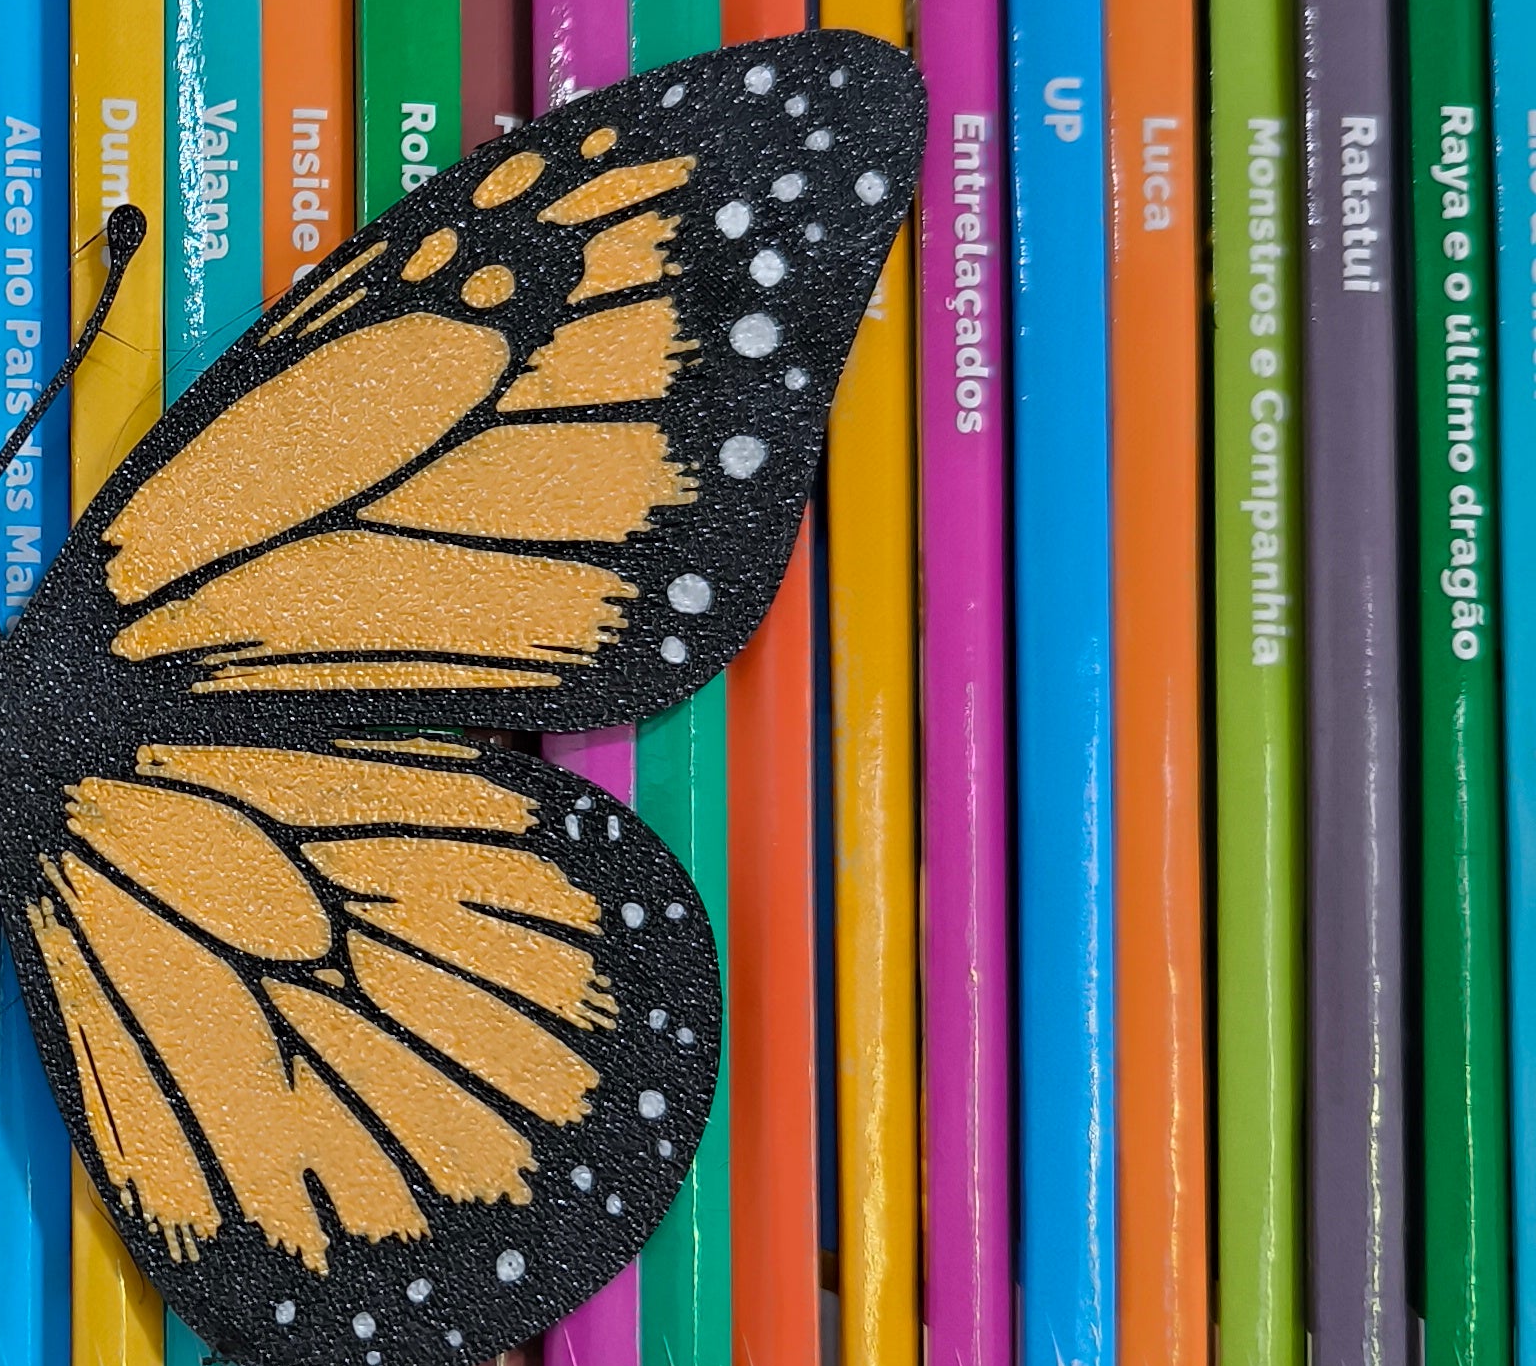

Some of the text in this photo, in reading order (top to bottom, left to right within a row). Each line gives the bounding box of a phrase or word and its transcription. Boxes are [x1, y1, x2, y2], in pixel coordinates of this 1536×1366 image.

[4, 116, 41, 237] Alice
[200, 99, 238, 261] Vaiana
[292, 108, 329, 252] Inside
[1043, 77, 1083, 143] UP
[1143, 118, 1178, 232] Luca
[946, 114, 990, 434] Entrelaçados
[1340, 116, 1379, 292] Ratatui
[4, 248, 33, 307] no
[4, 319, 41, 414] País
[1241, 118, 1289, 667] Monstros e Companhia
[1431, 106, 1483, 661] Raya e o último dragão
